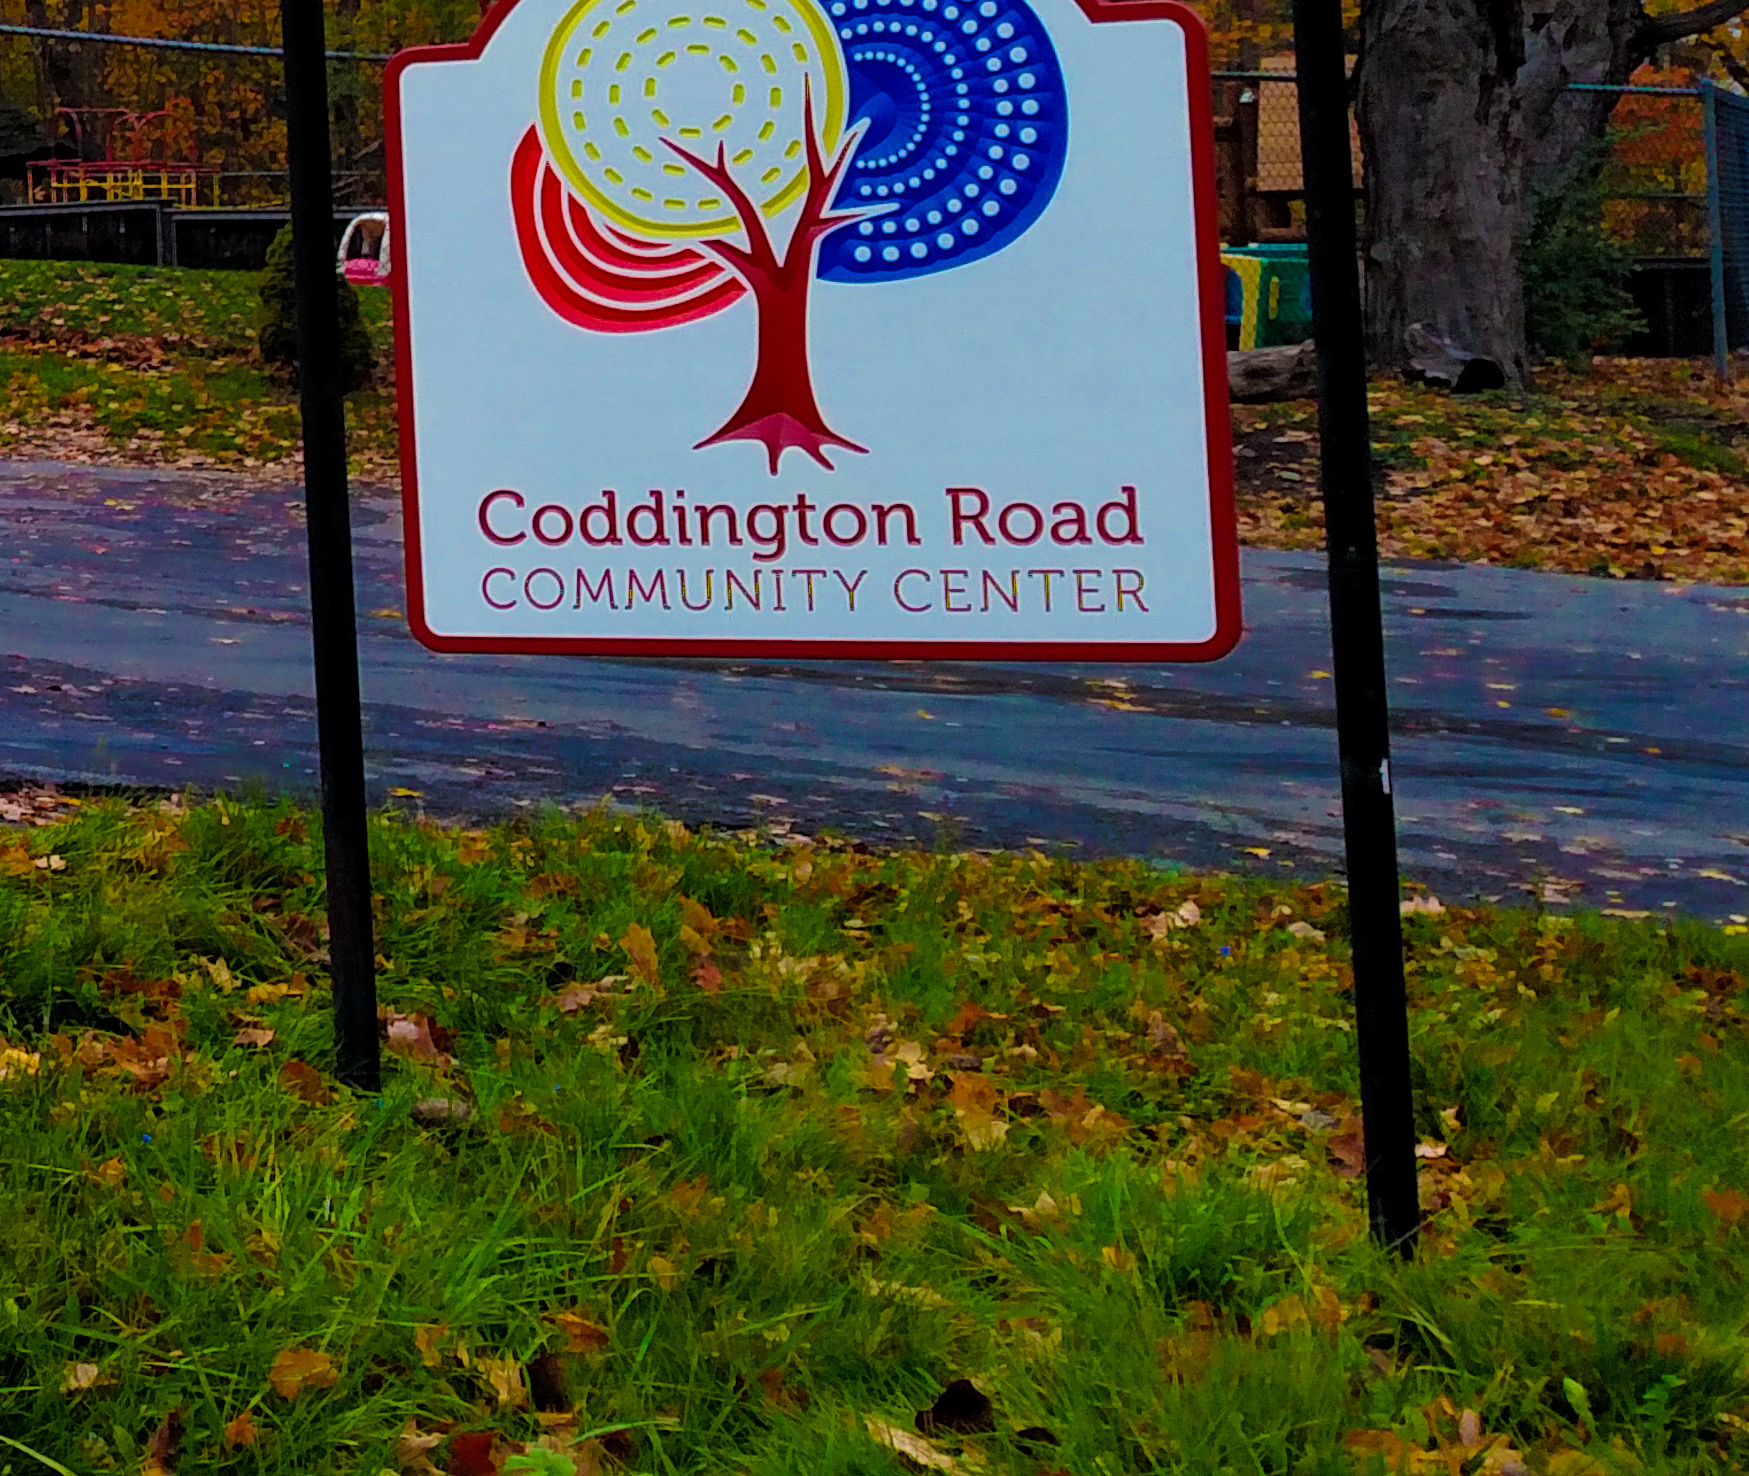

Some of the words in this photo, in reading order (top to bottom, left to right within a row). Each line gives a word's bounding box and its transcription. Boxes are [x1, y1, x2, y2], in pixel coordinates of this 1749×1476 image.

[477, 489, 922, 563] Coddington
[944, 485, 1145, 547] Road
[480, 567, 868, 612] COMMUNITY
[893, 569, 1150, 613] CENTER
